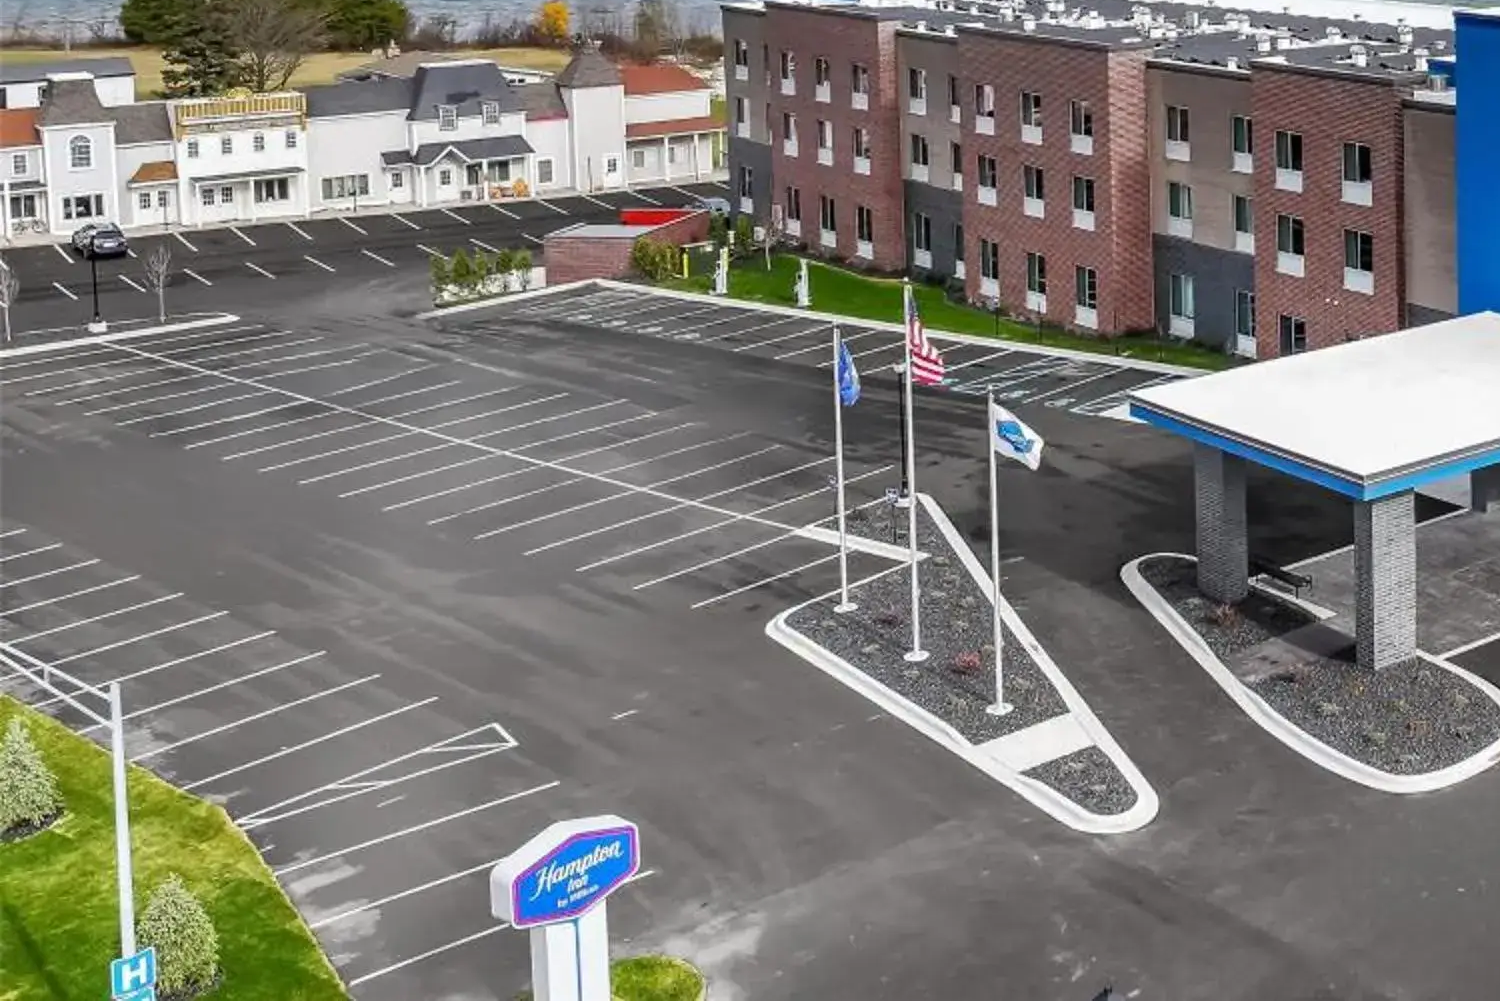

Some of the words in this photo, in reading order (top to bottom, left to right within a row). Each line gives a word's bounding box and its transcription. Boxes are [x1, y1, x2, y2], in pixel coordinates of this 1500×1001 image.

[530, 840, 624, 901] Hampton
[567, 874, 589, 894] Inn
[122, 956, 147, 992] H
